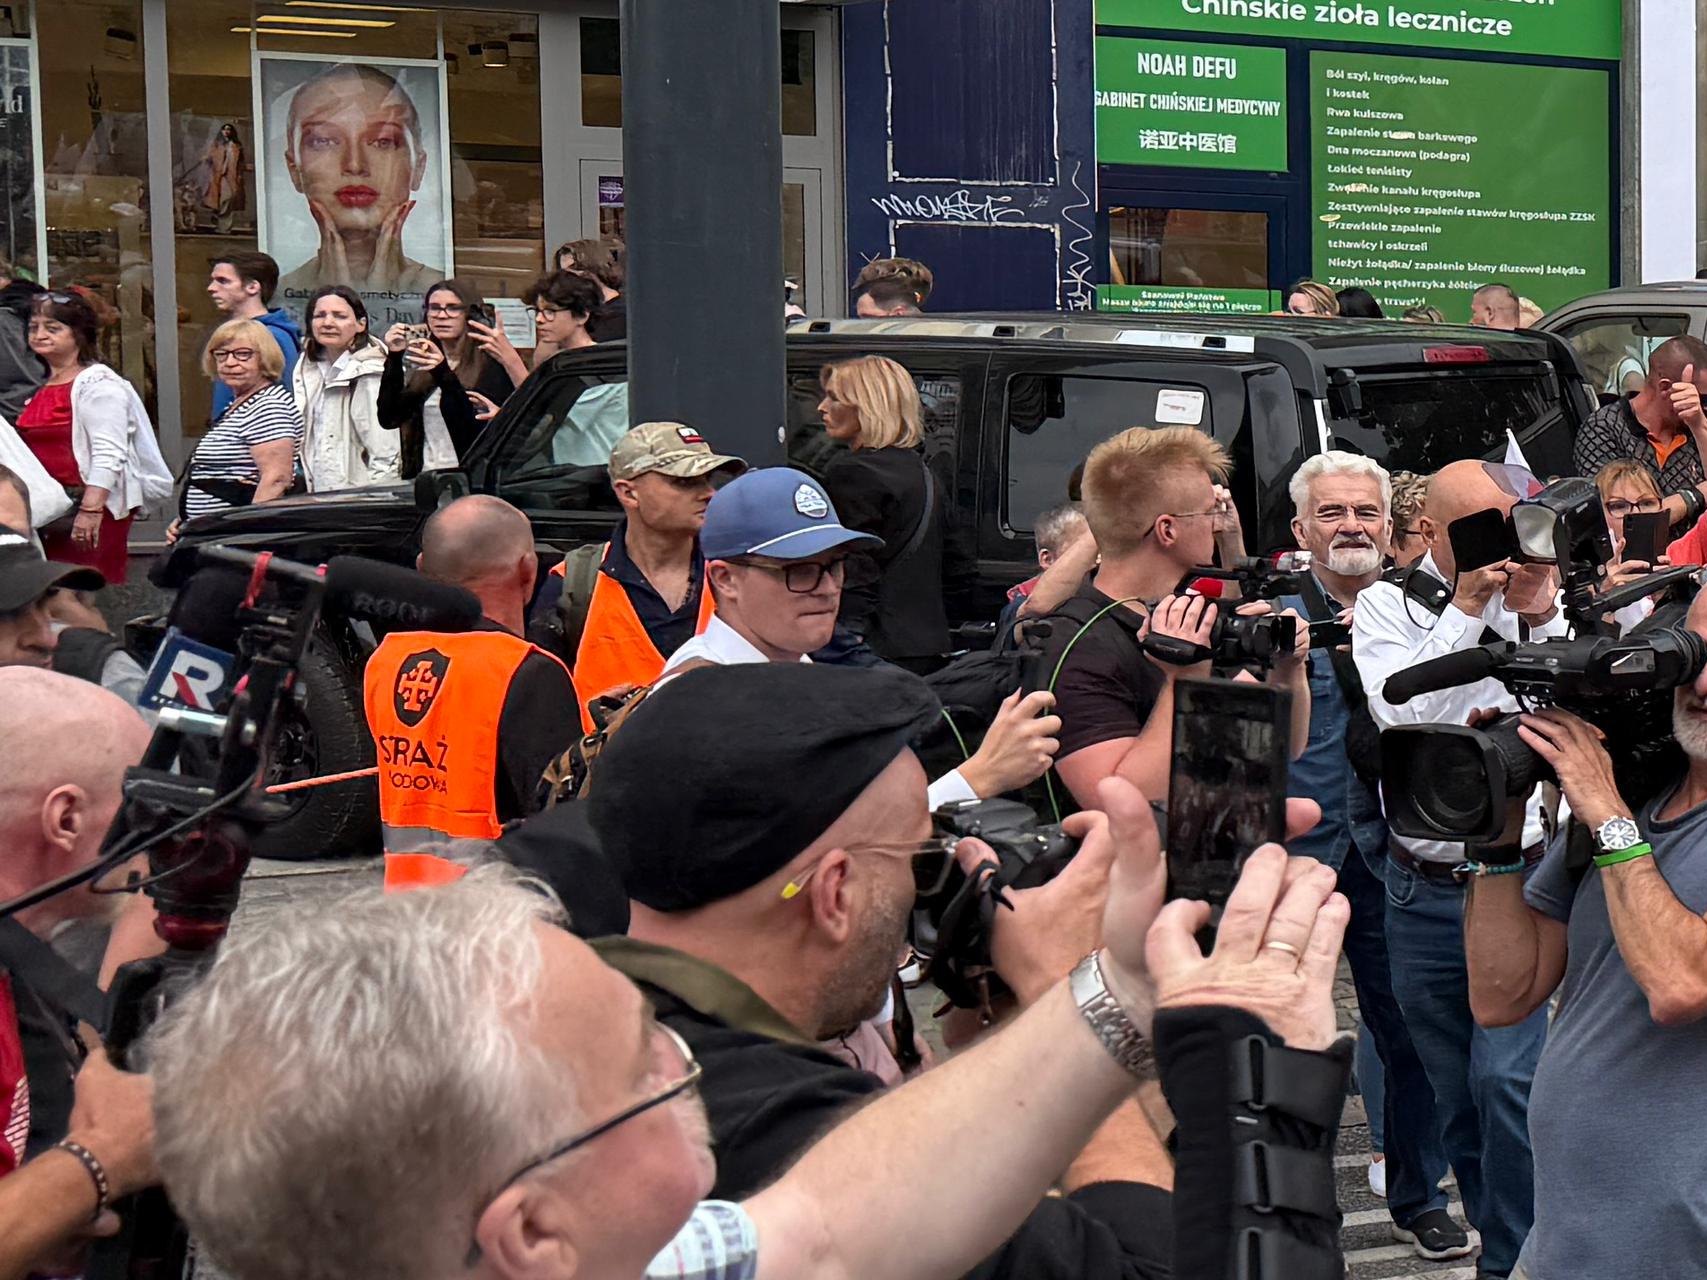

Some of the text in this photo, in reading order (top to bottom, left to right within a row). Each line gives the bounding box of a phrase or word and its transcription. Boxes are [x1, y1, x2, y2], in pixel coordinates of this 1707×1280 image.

[1314, 2, 1380, 27] zioła
[1388, 5, 1513, 37] lecznicze
[1137, 52, 1237, 80] NOAH DEFU
[1095, 90, 1281, 117] GABINET CHIŃSKIEJ MEDYCYNY
[1333, 89, 1370, 100] kostek
